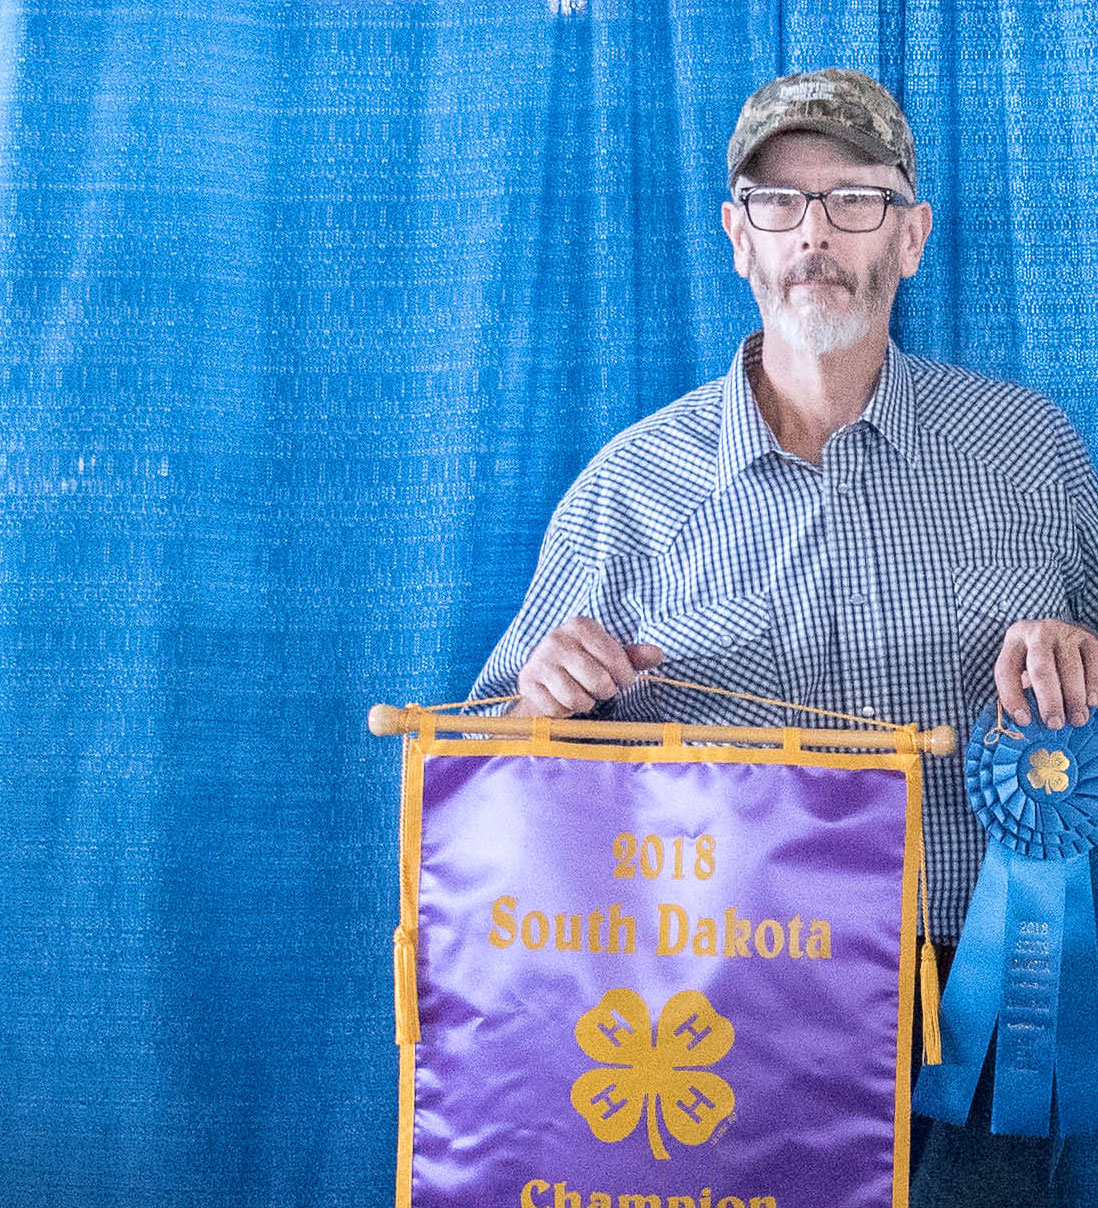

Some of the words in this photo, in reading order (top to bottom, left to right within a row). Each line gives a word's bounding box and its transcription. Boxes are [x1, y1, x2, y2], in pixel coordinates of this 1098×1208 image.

[612, 832, 716, 880] 2018
[488, 895, 637, 955] South
[655, 903, 832, 960] Dakota
